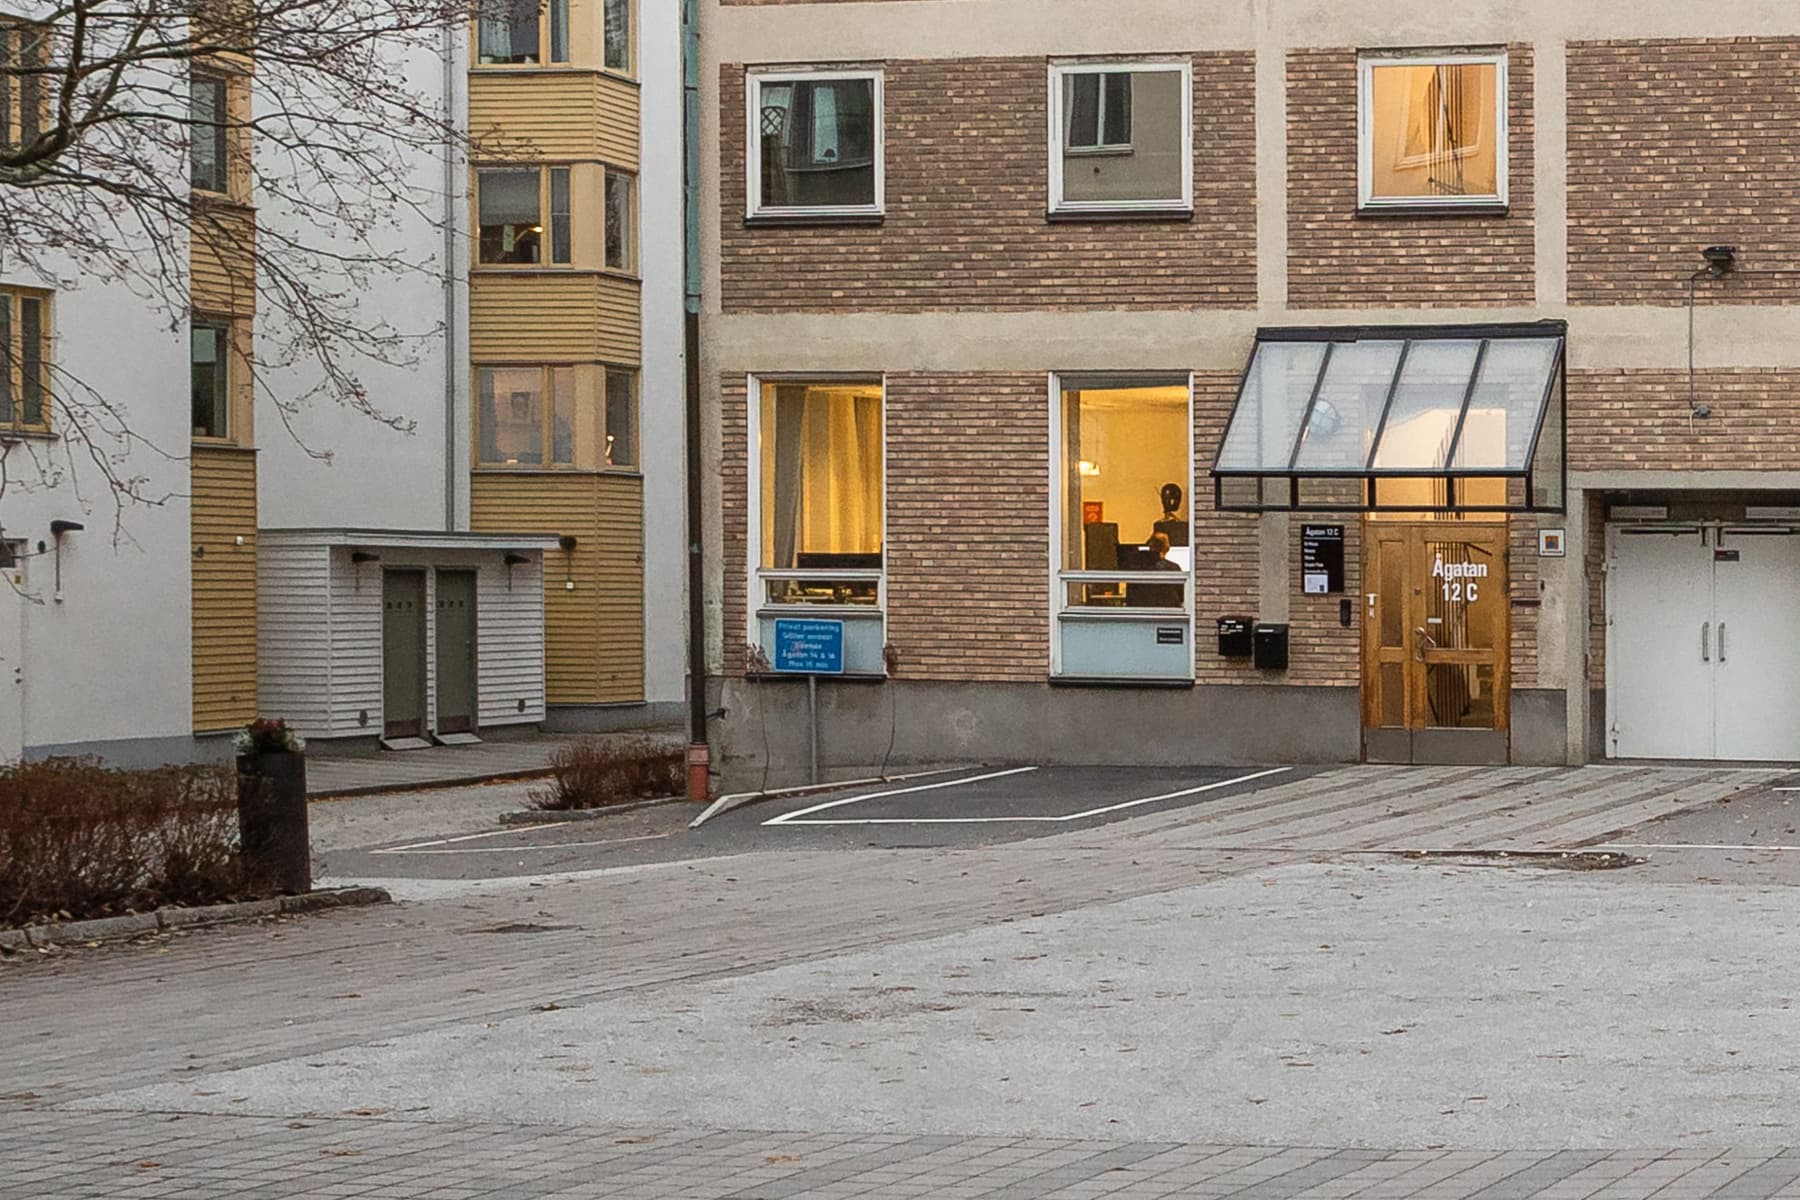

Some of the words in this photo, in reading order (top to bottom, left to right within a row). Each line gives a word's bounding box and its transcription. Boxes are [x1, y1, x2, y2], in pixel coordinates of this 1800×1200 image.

[1432, 552, 1488, 581] Ågatan
[1442, 583, 1461, 602] 12
[1466, 582, 1478, 602] C
